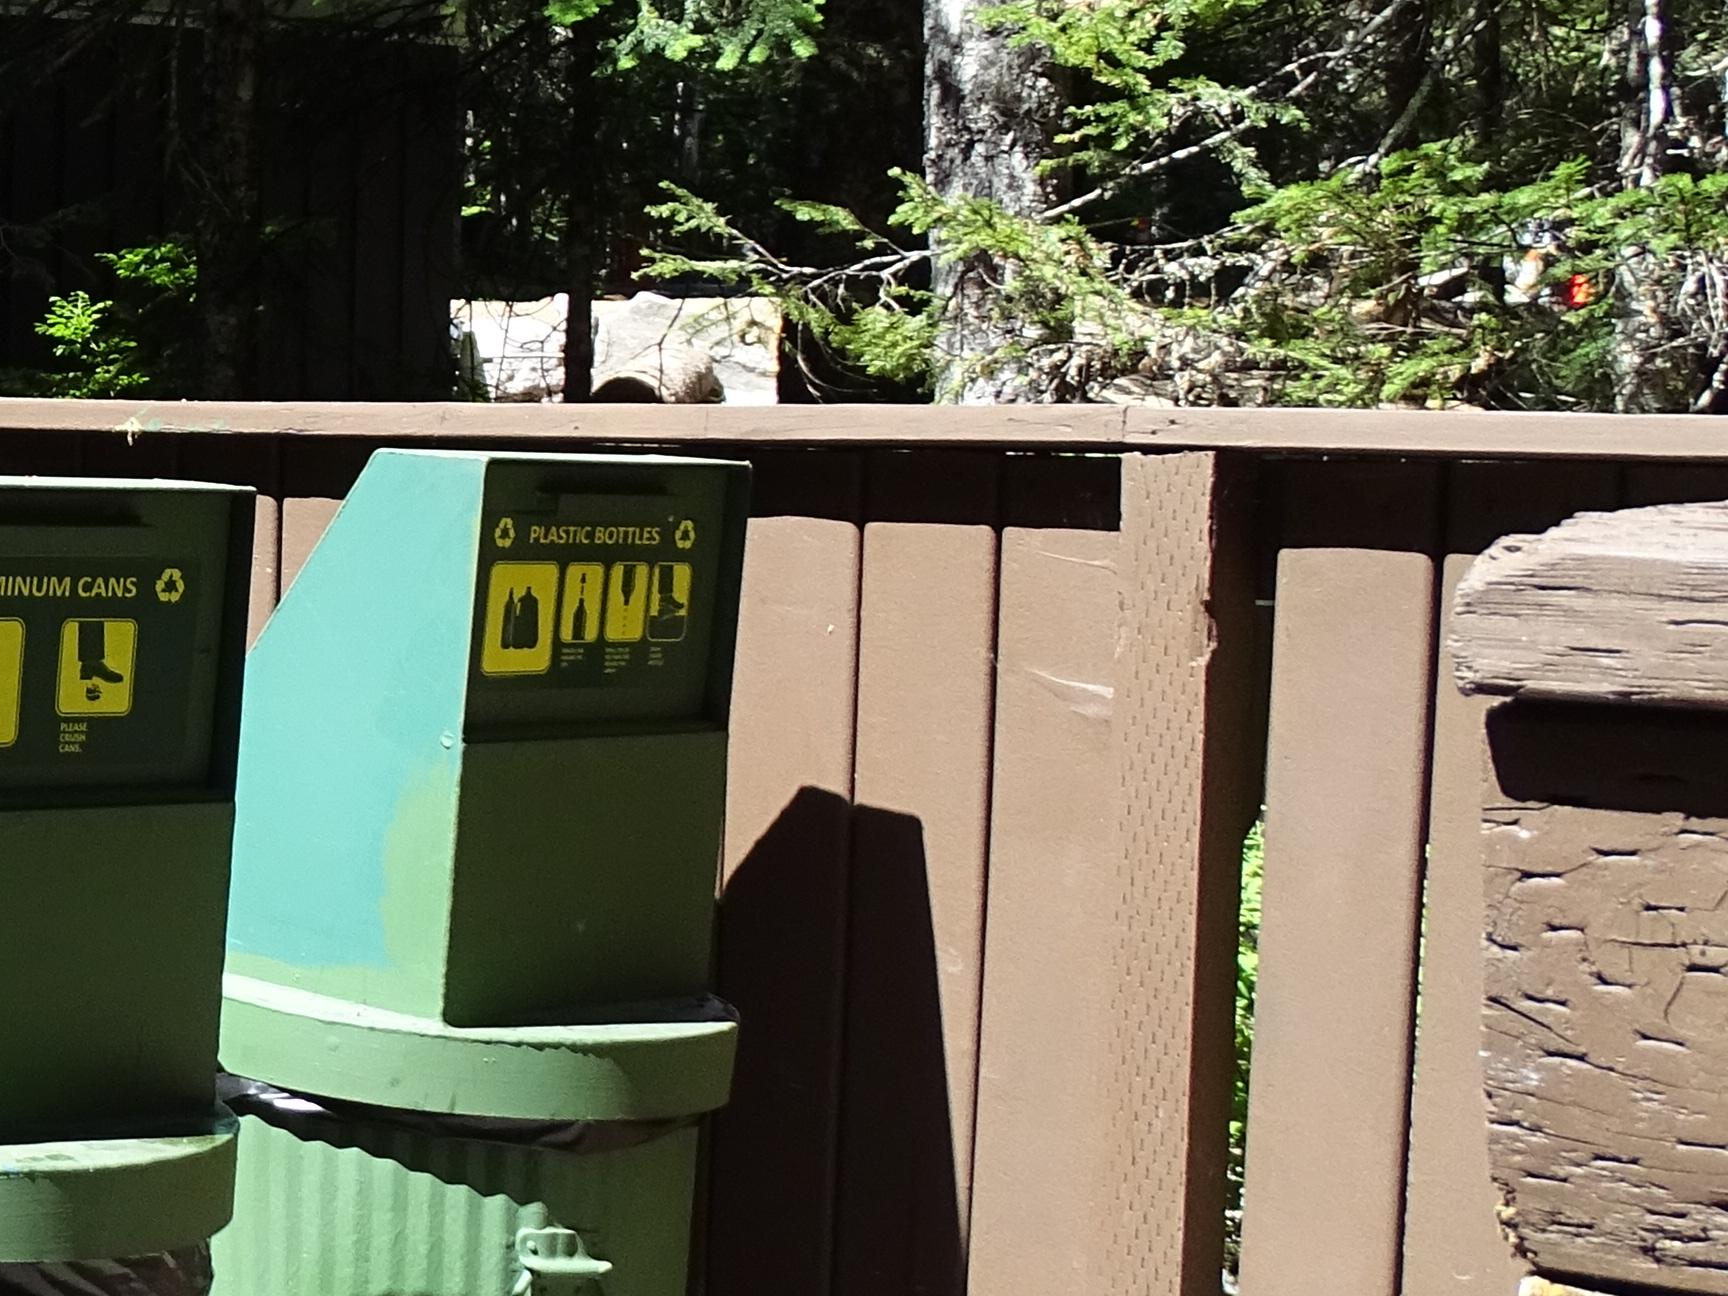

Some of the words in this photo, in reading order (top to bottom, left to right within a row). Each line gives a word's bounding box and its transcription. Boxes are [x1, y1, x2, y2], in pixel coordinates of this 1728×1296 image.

[529, 526, 592, 545] PLASTIC
[595, 527, 661, 545] BOTTLES
[77, 576, 137, 598] CANS
[59, 722, 88, 732] PLEASE
[58, 743, 83, 753] CANS.
